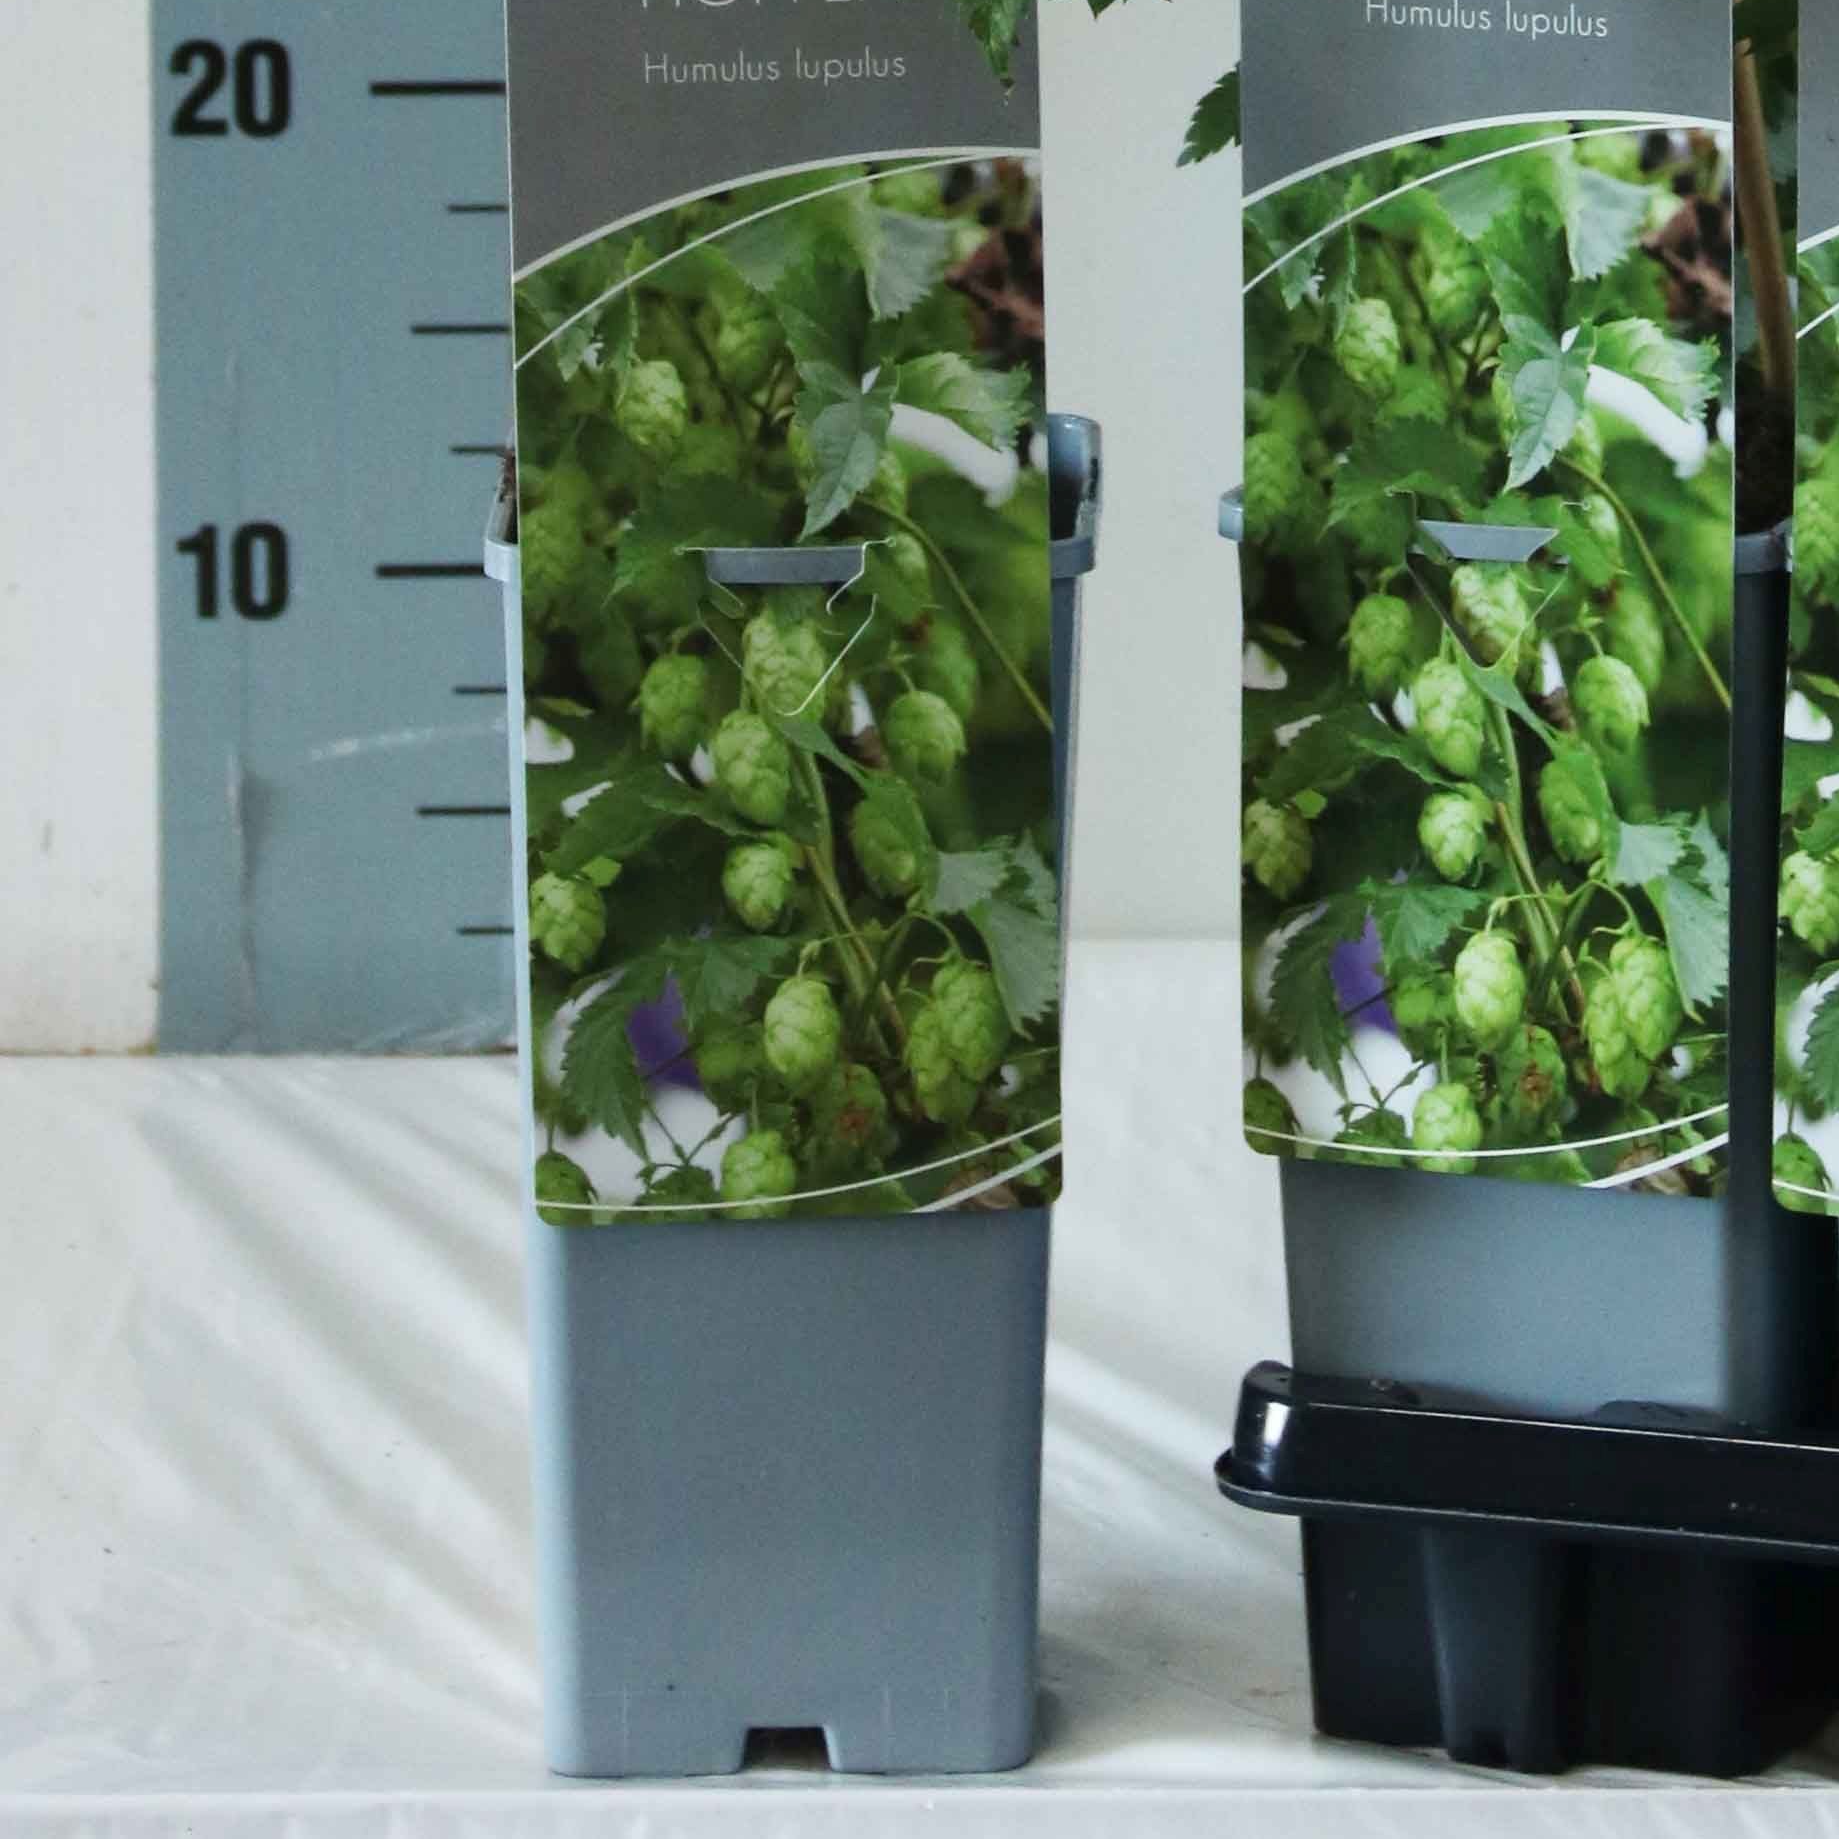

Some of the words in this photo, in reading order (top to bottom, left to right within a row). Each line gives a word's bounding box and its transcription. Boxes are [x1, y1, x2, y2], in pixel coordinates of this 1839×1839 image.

[1505, 0, 1609, 42] lupulus
[168, 37, 293, 140] 20
[644, 50, 782, 85] Humulus
[795, 45, 907, 88] lupulus
[174, 521, 291, 622] 10
